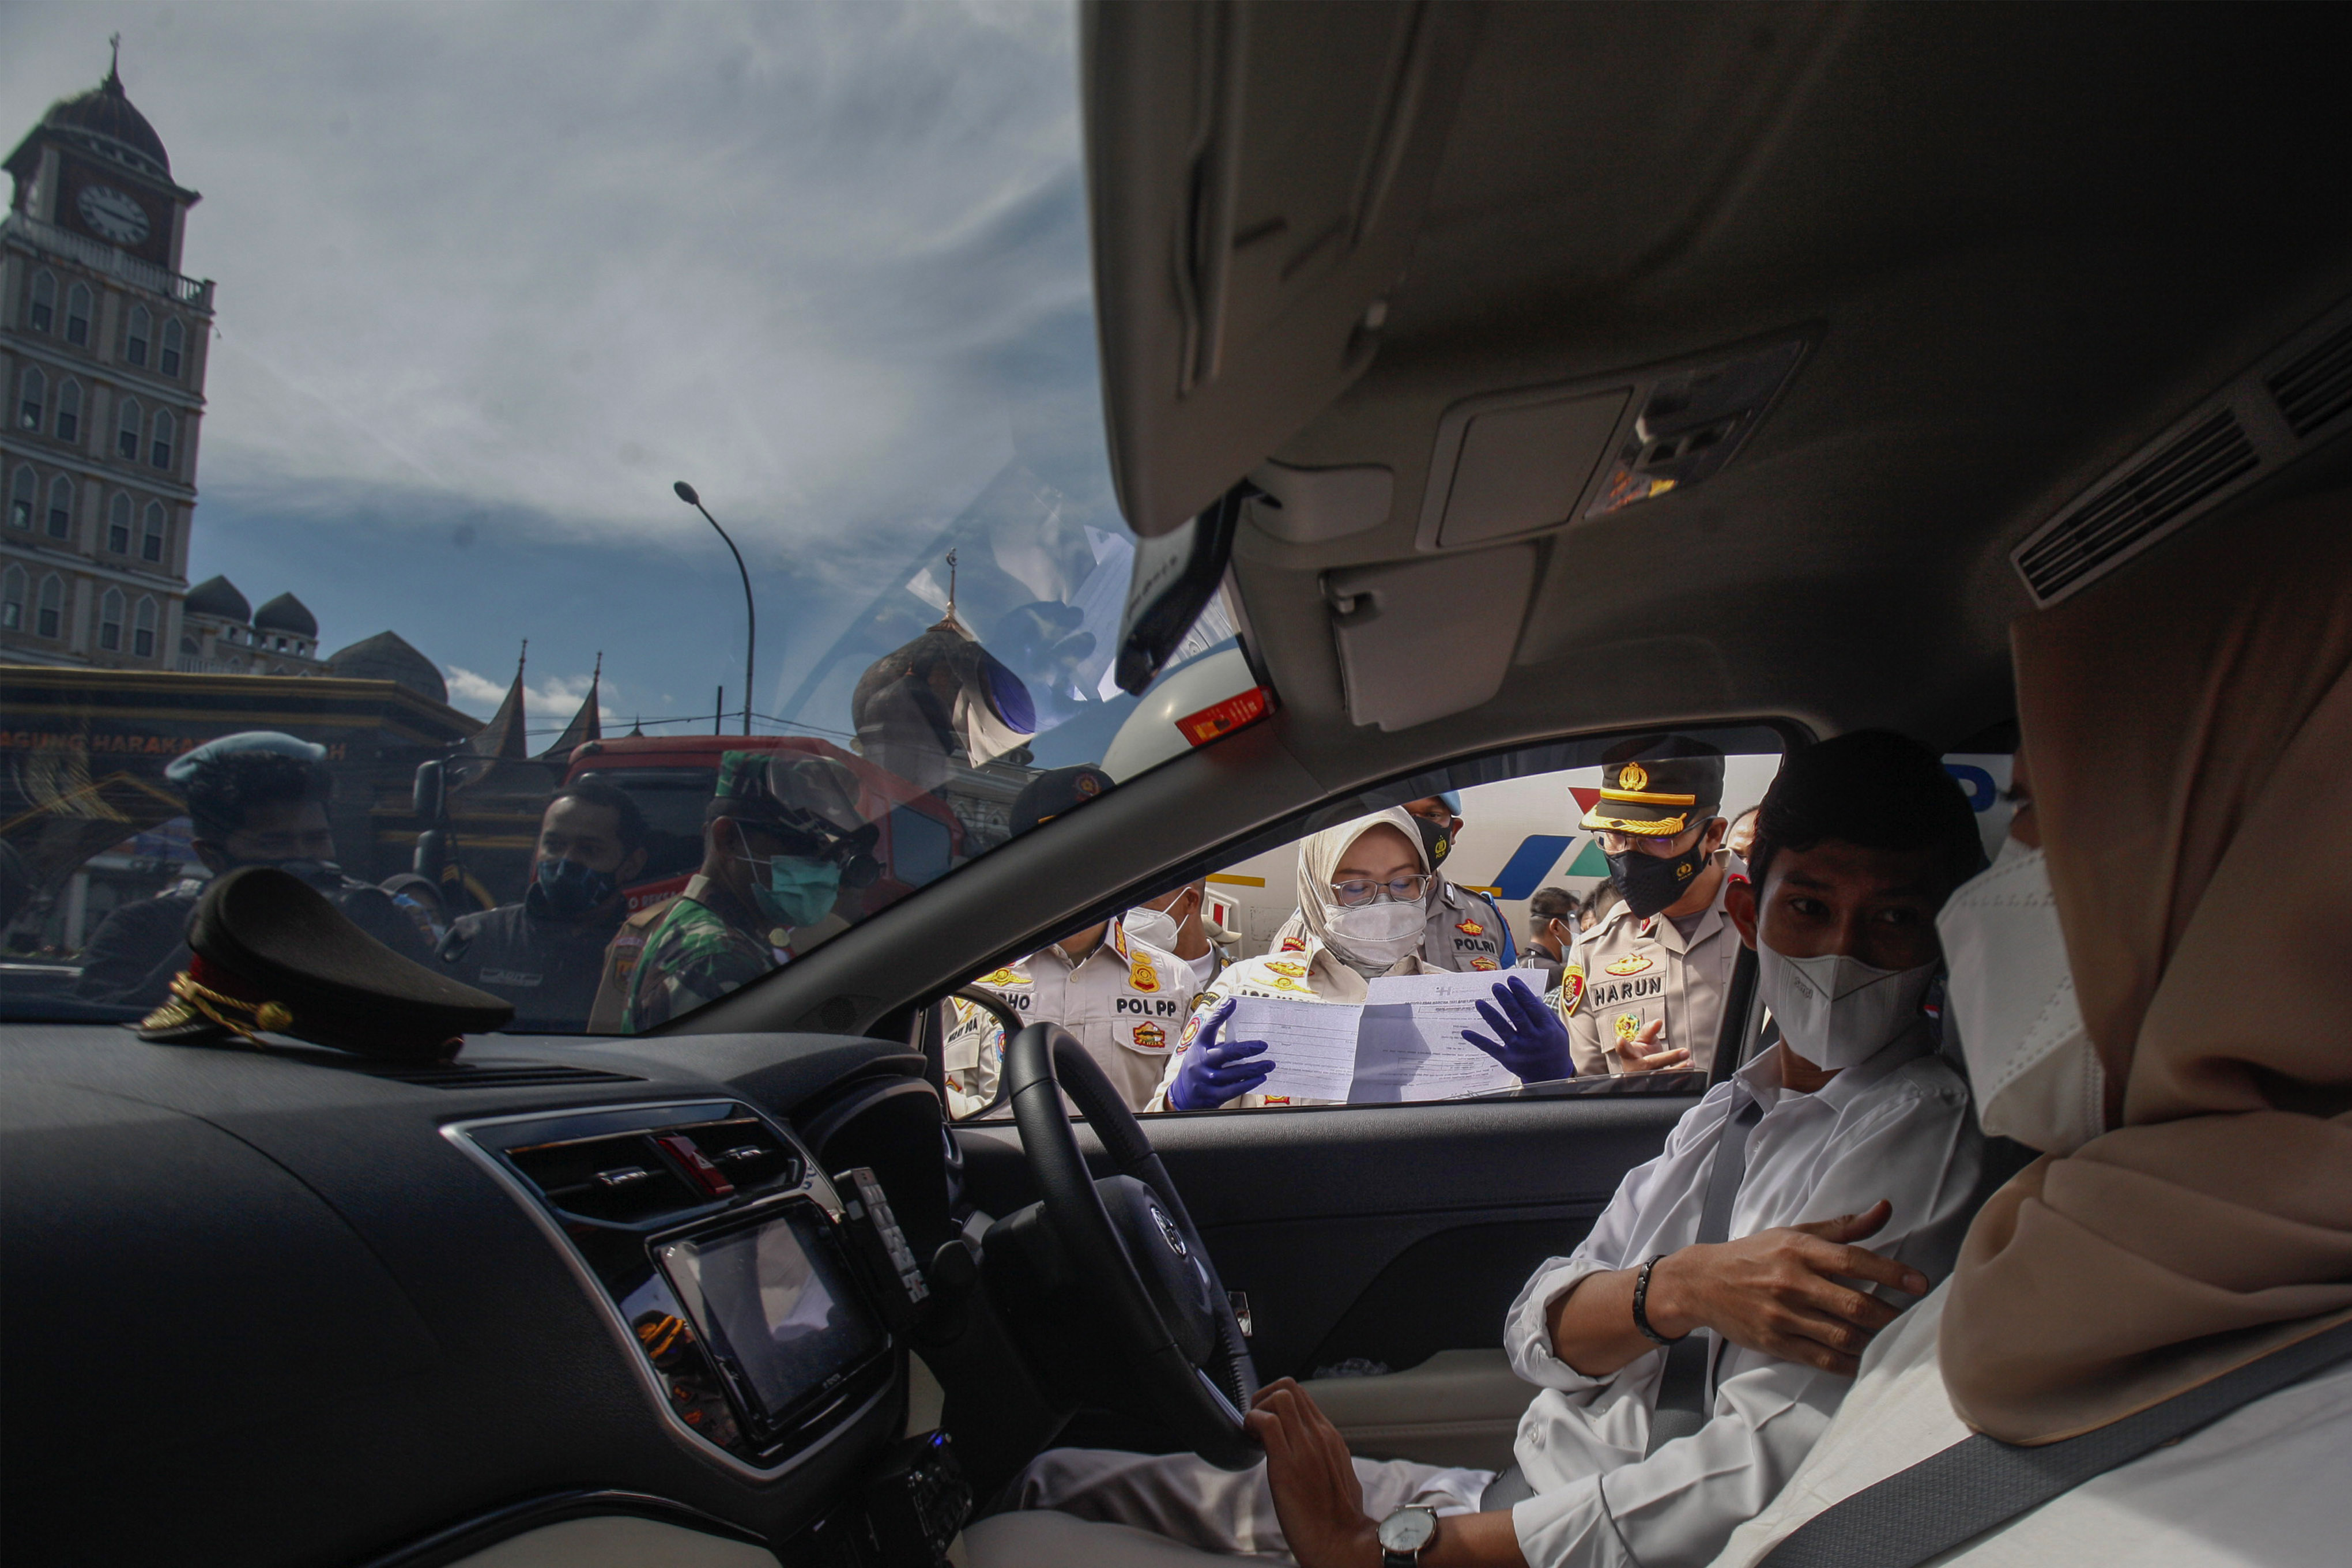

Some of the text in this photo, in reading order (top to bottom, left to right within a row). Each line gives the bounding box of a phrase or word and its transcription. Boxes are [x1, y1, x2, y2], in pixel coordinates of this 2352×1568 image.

[93, 734, 206, 753] HARAKA
[1454, 938, 1495, 953] POLRI
[1595, 977, 1661, 1006] HARUN
[1117, 998, 1176, 1017] POL PP
